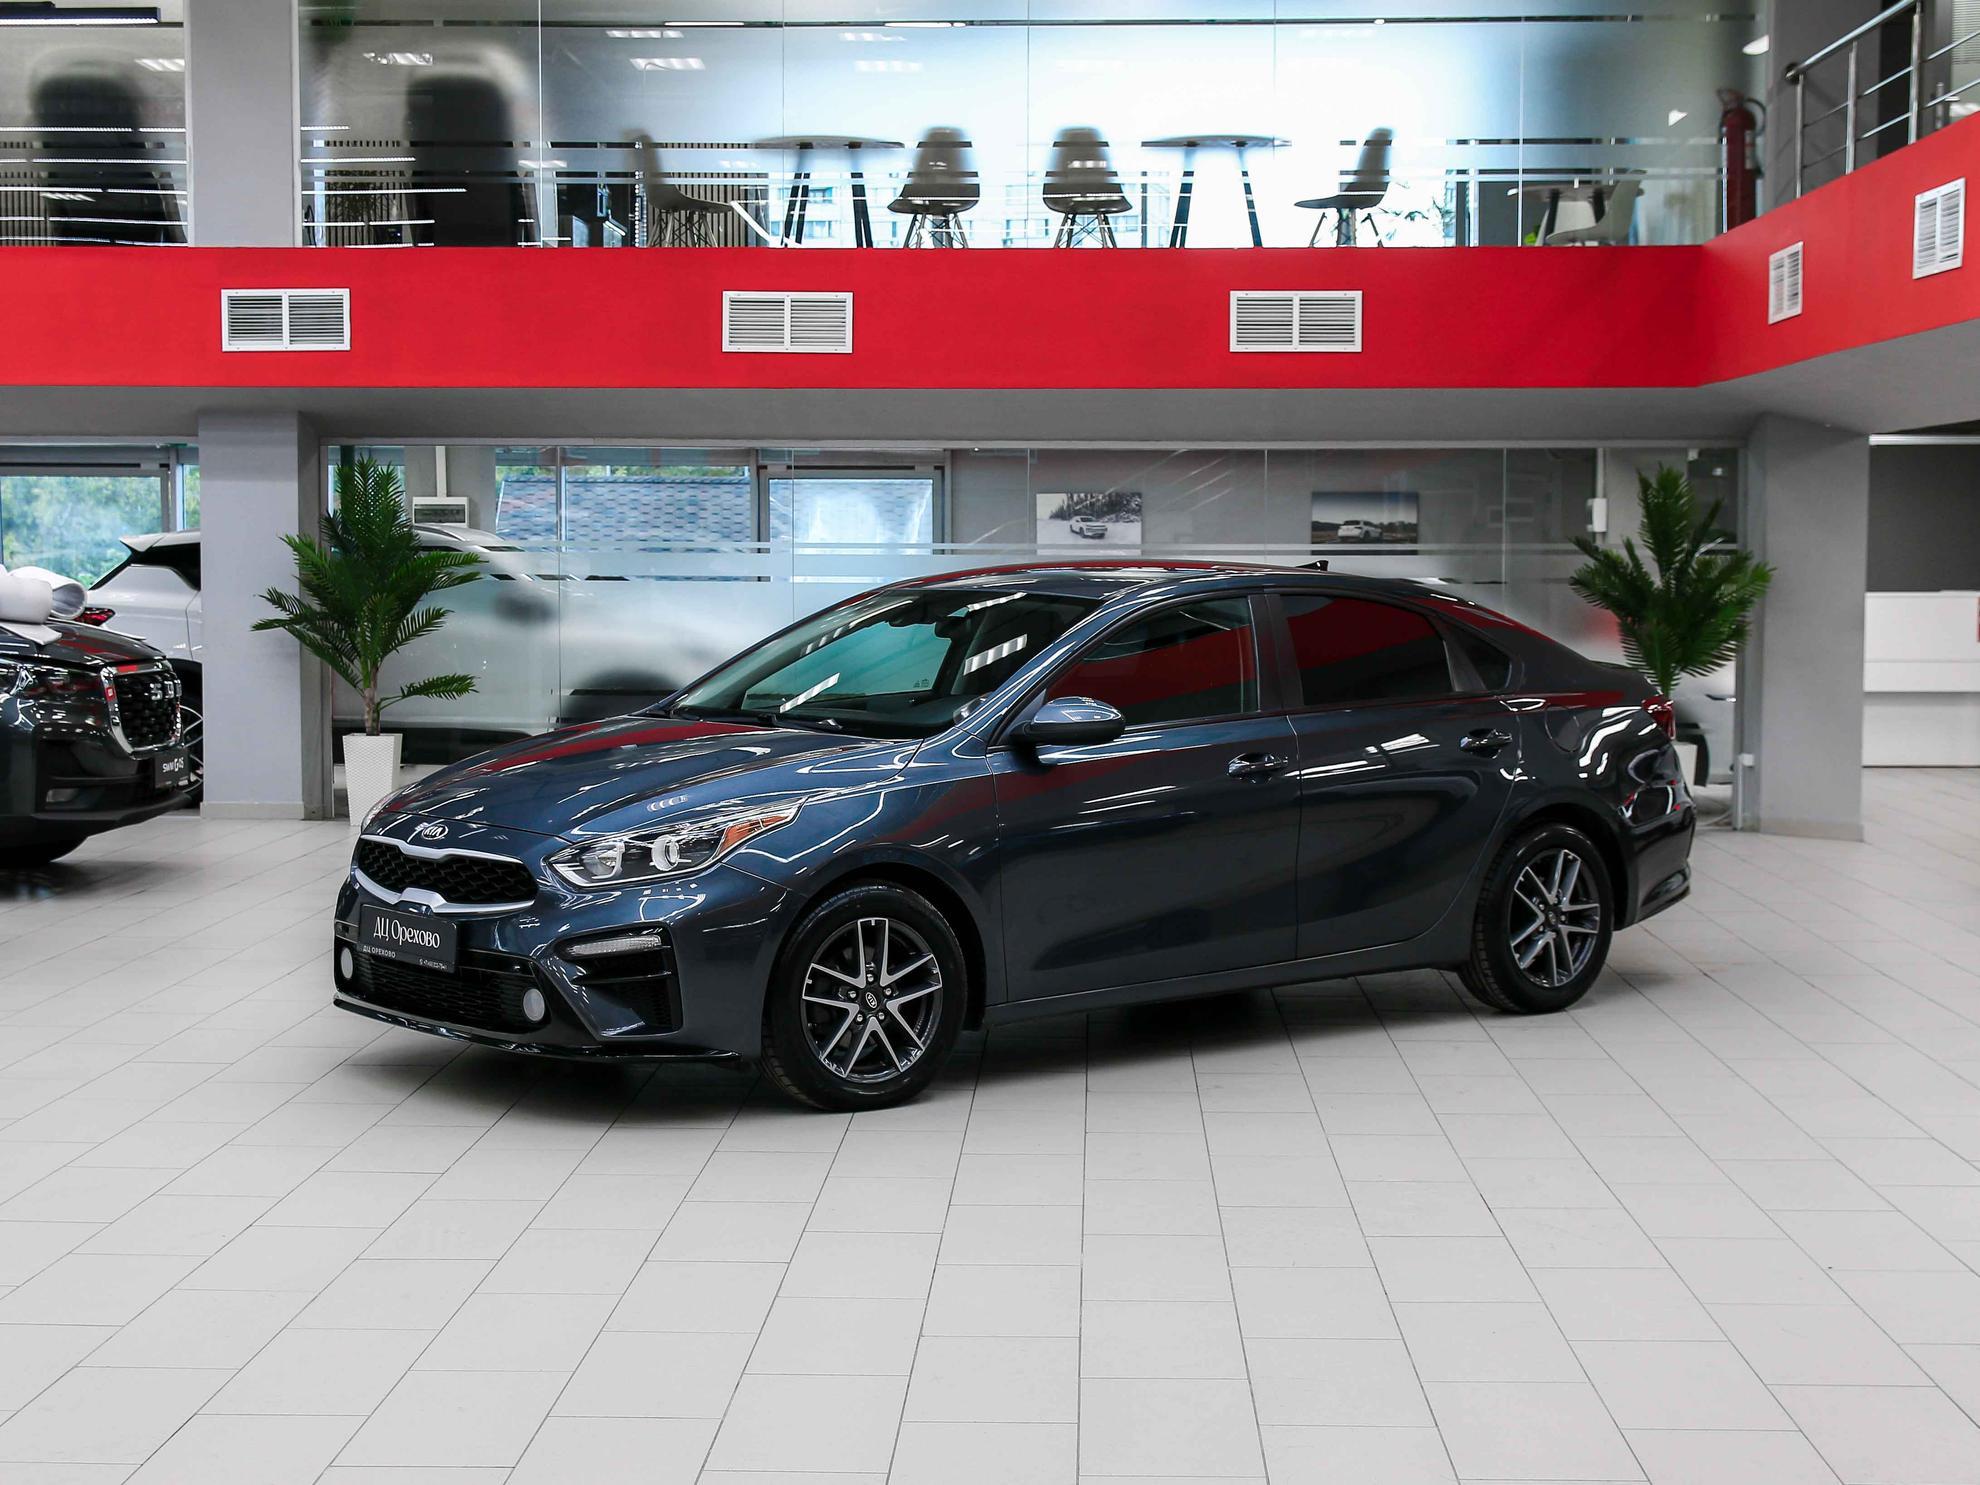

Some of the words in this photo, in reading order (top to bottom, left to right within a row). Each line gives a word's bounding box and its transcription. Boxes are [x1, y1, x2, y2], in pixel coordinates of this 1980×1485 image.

[424, 826, 443, 836] KIA
[373, 916, 389, 941] ДЦ
[391, 919, 440, 948] Орехово
[362, 945, 371, 953] ДЦ
[371, 946, 396, 959] ОРЕХОВО
